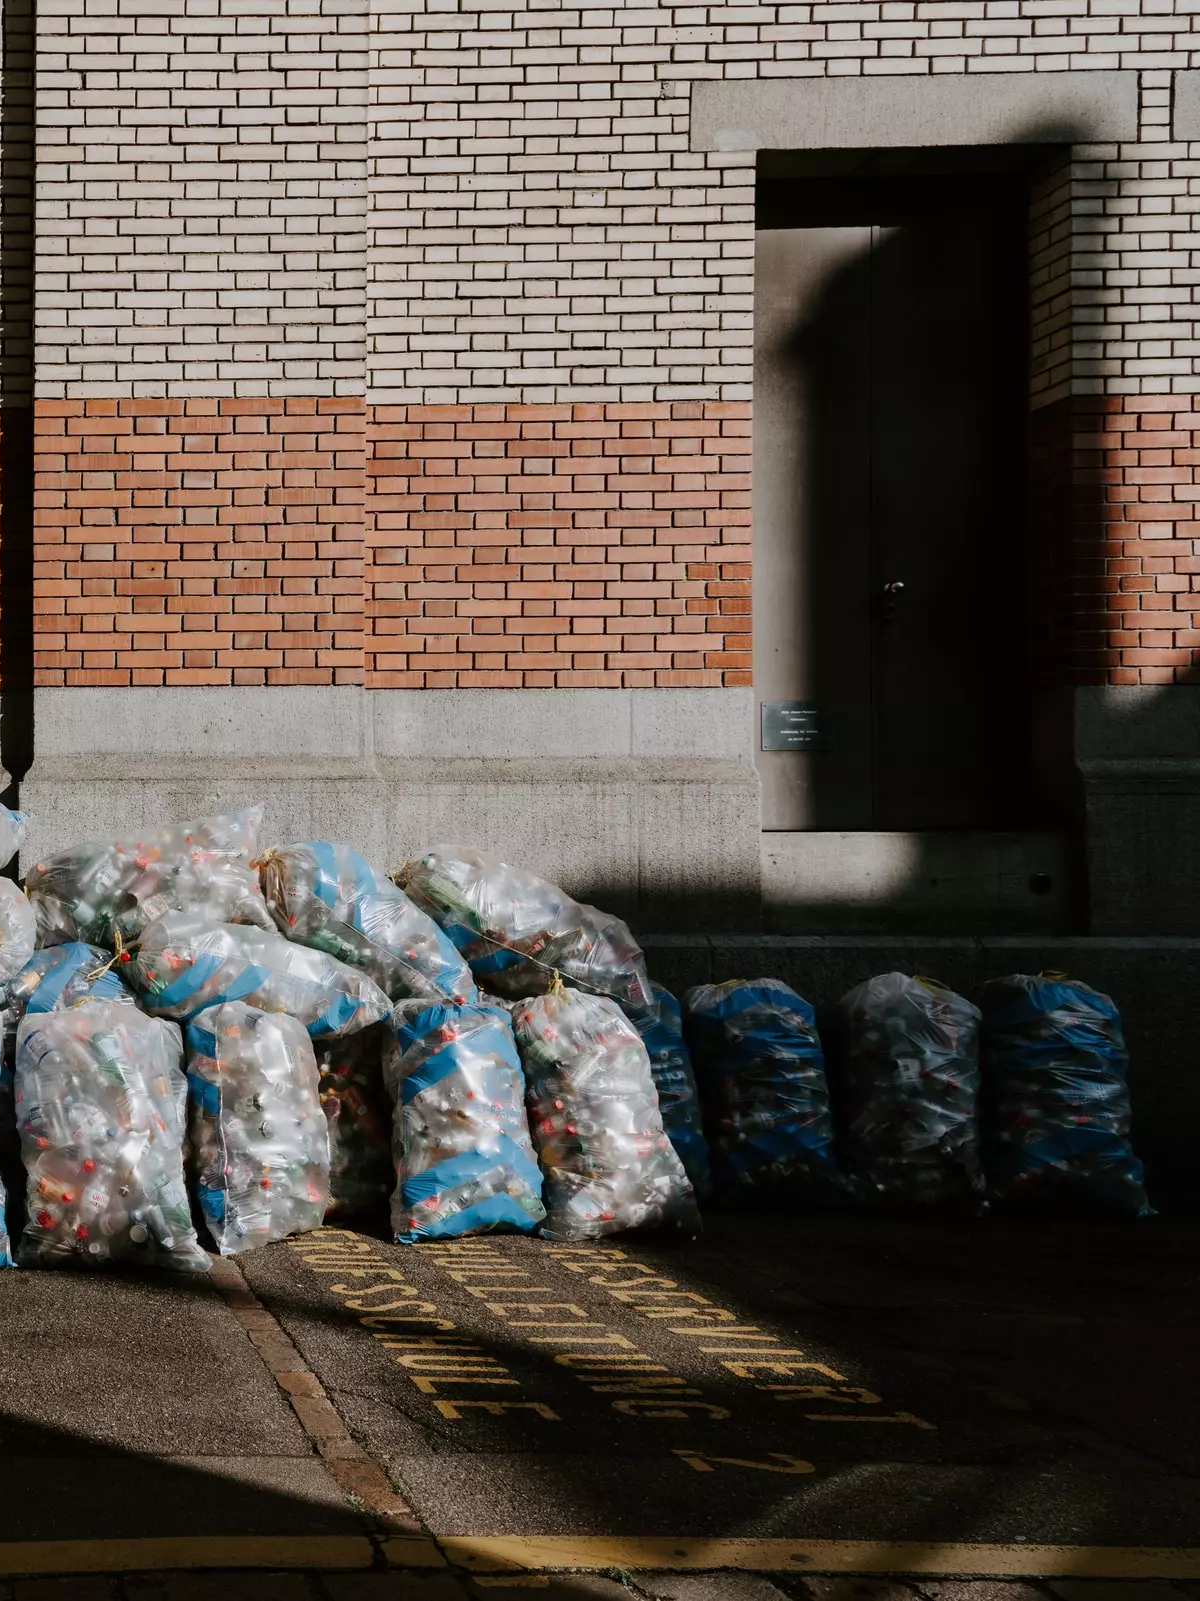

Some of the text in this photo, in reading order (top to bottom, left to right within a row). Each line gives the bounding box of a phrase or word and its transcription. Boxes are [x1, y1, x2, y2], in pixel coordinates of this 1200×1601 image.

[283, 1226, 562, 1419] ERUFSSCHULE
[412, 1236, 816, 1474] HULLEITUNG 2
[540, 1248, 938, 1430] RESERVIERT
